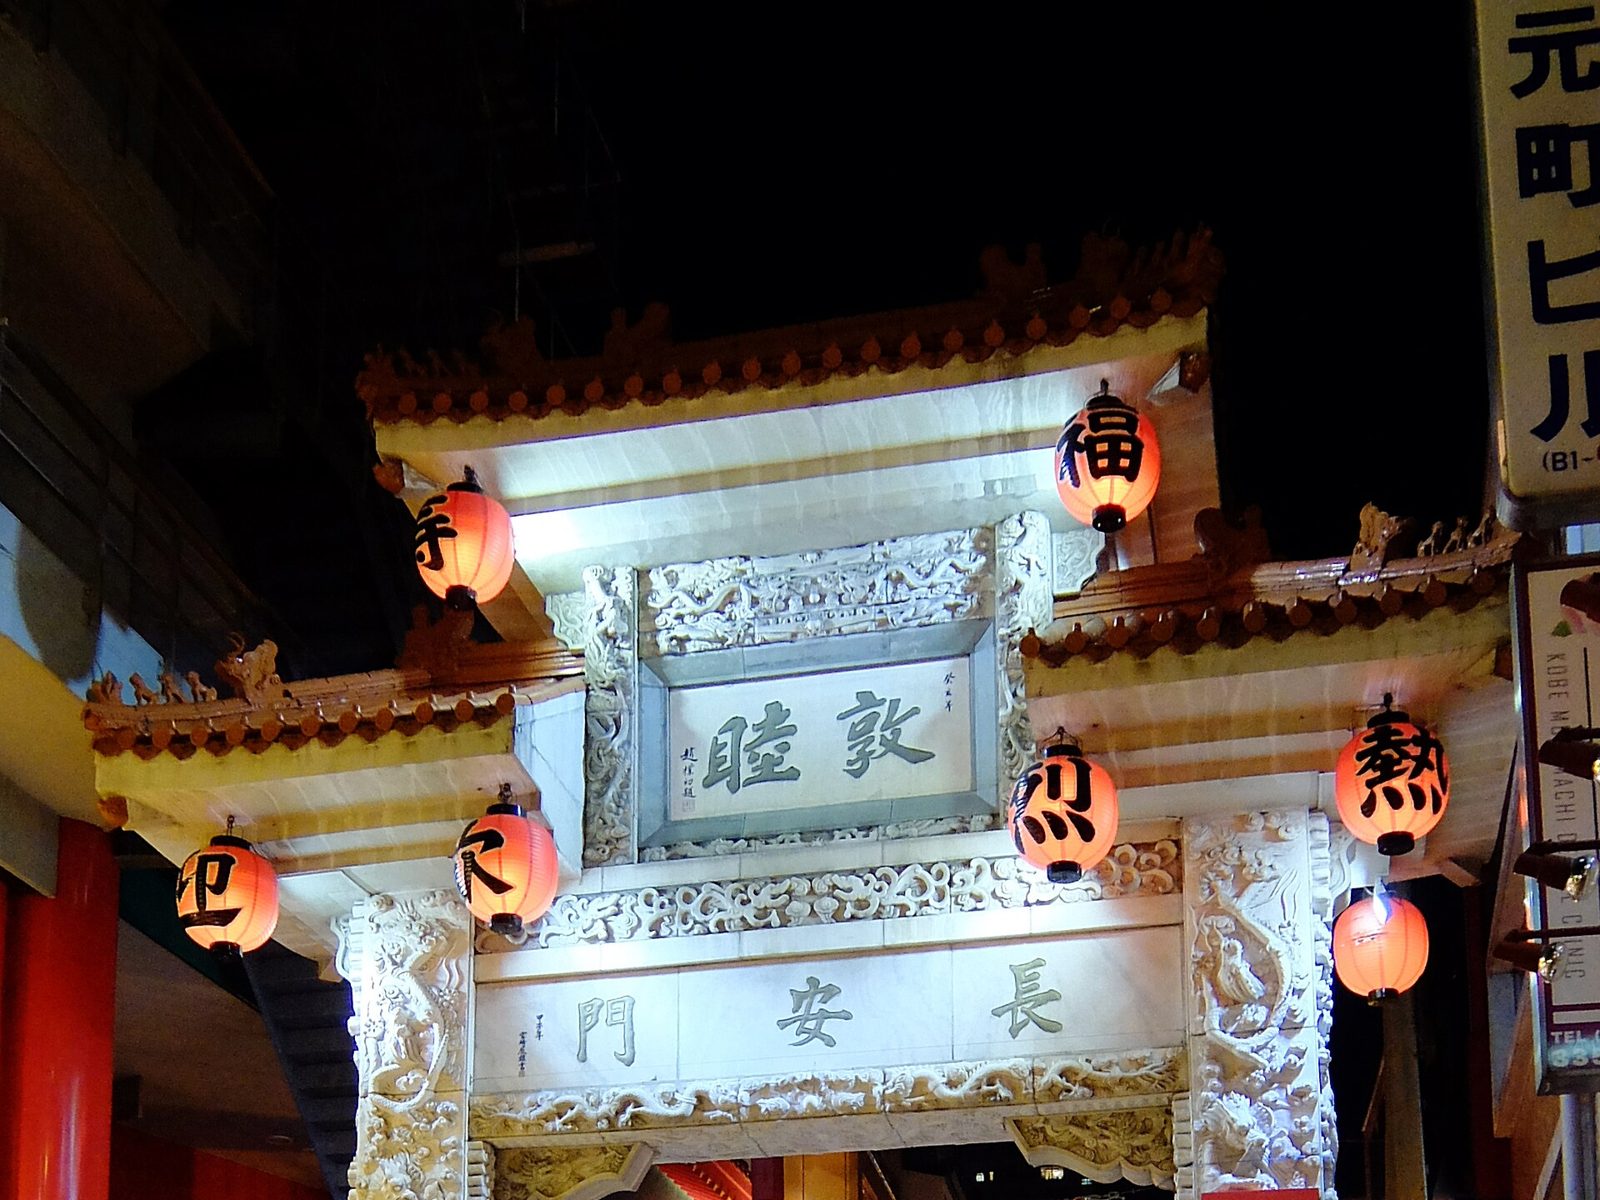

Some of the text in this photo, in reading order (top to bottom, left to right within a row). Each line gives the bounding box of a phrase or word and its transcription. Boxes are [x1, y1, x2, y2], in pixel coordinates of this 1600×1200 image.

[1057, 406, 1145, 489] 福
[1542, 449, 1600, 473] (B1-
[1547, 652, 1570, 700] KOBE
[702, 690, 935, 795] 敦睦
[1357, 724, 1449, 819] 熱
[577, 957, 1062, 1067] 長安門
